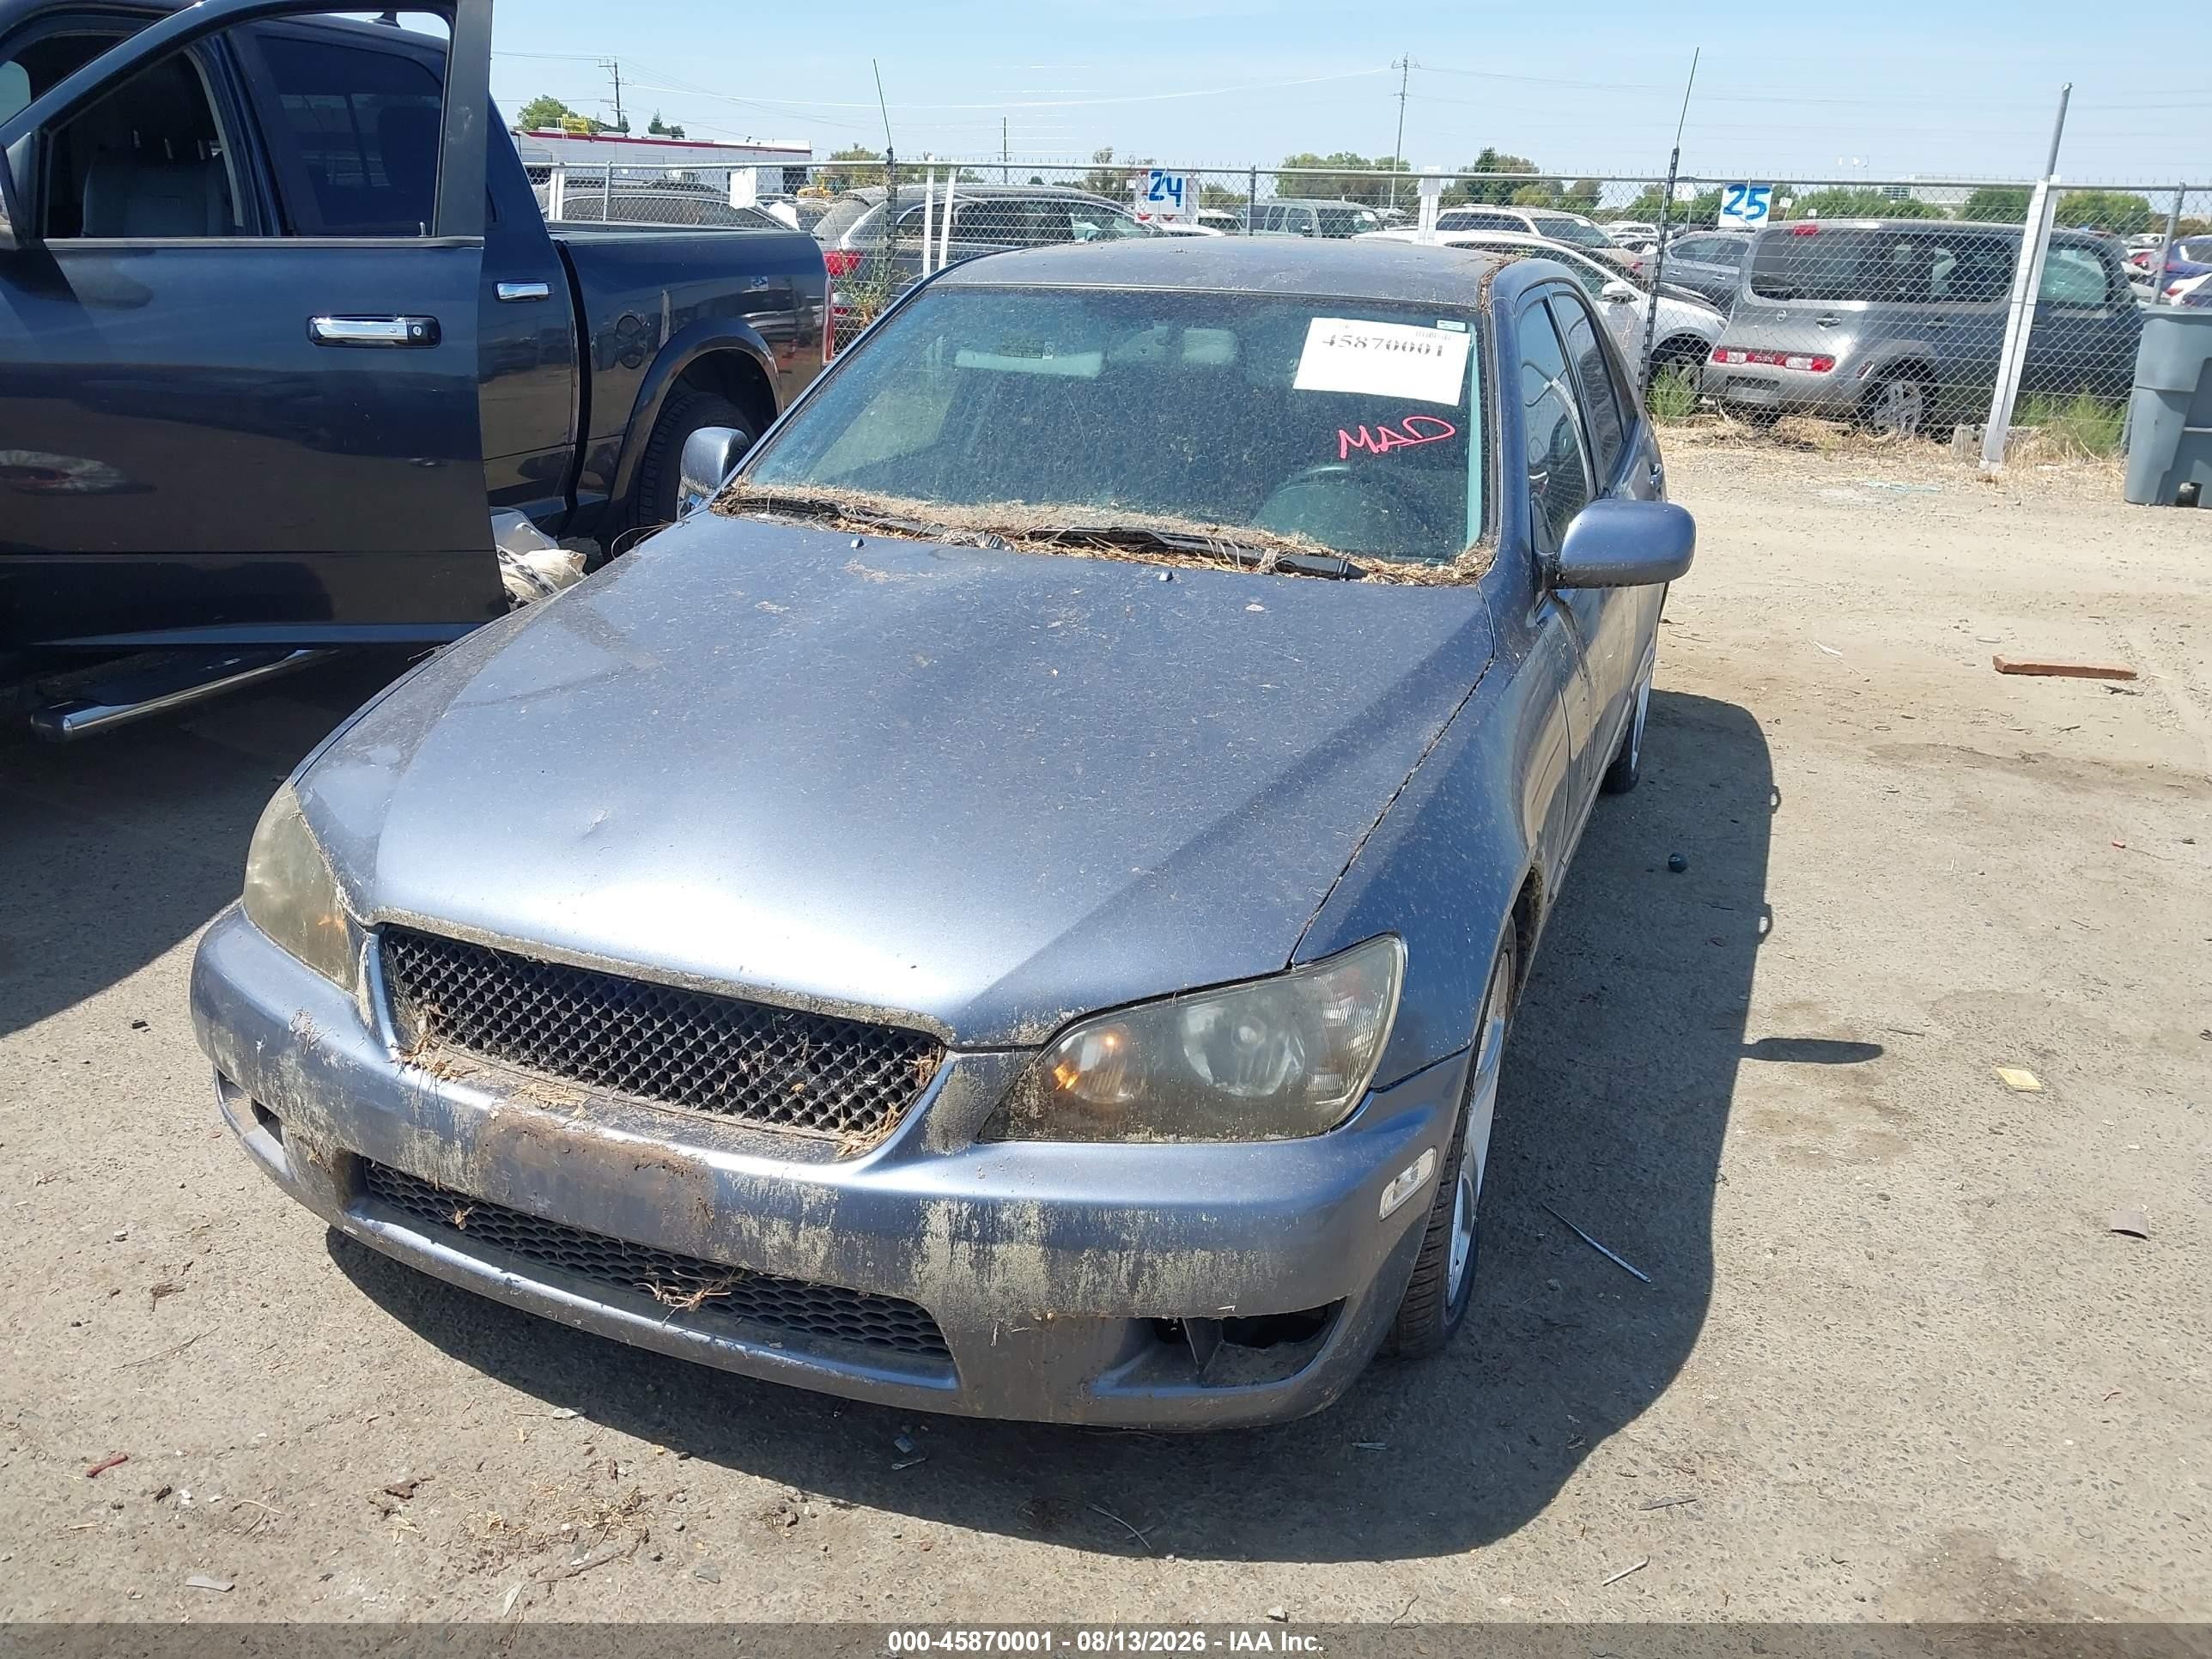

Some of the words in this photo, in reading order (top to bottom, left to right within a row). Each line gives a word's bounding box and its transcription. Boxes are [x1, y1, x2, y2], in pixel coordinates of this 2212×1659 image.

[1148, 171, 1182, 208] 24
[1723, 183, 1771, 221] 25
[1322, 334, 1443, 357] 45870001
[1338, 415, 1456, 459] MAD
